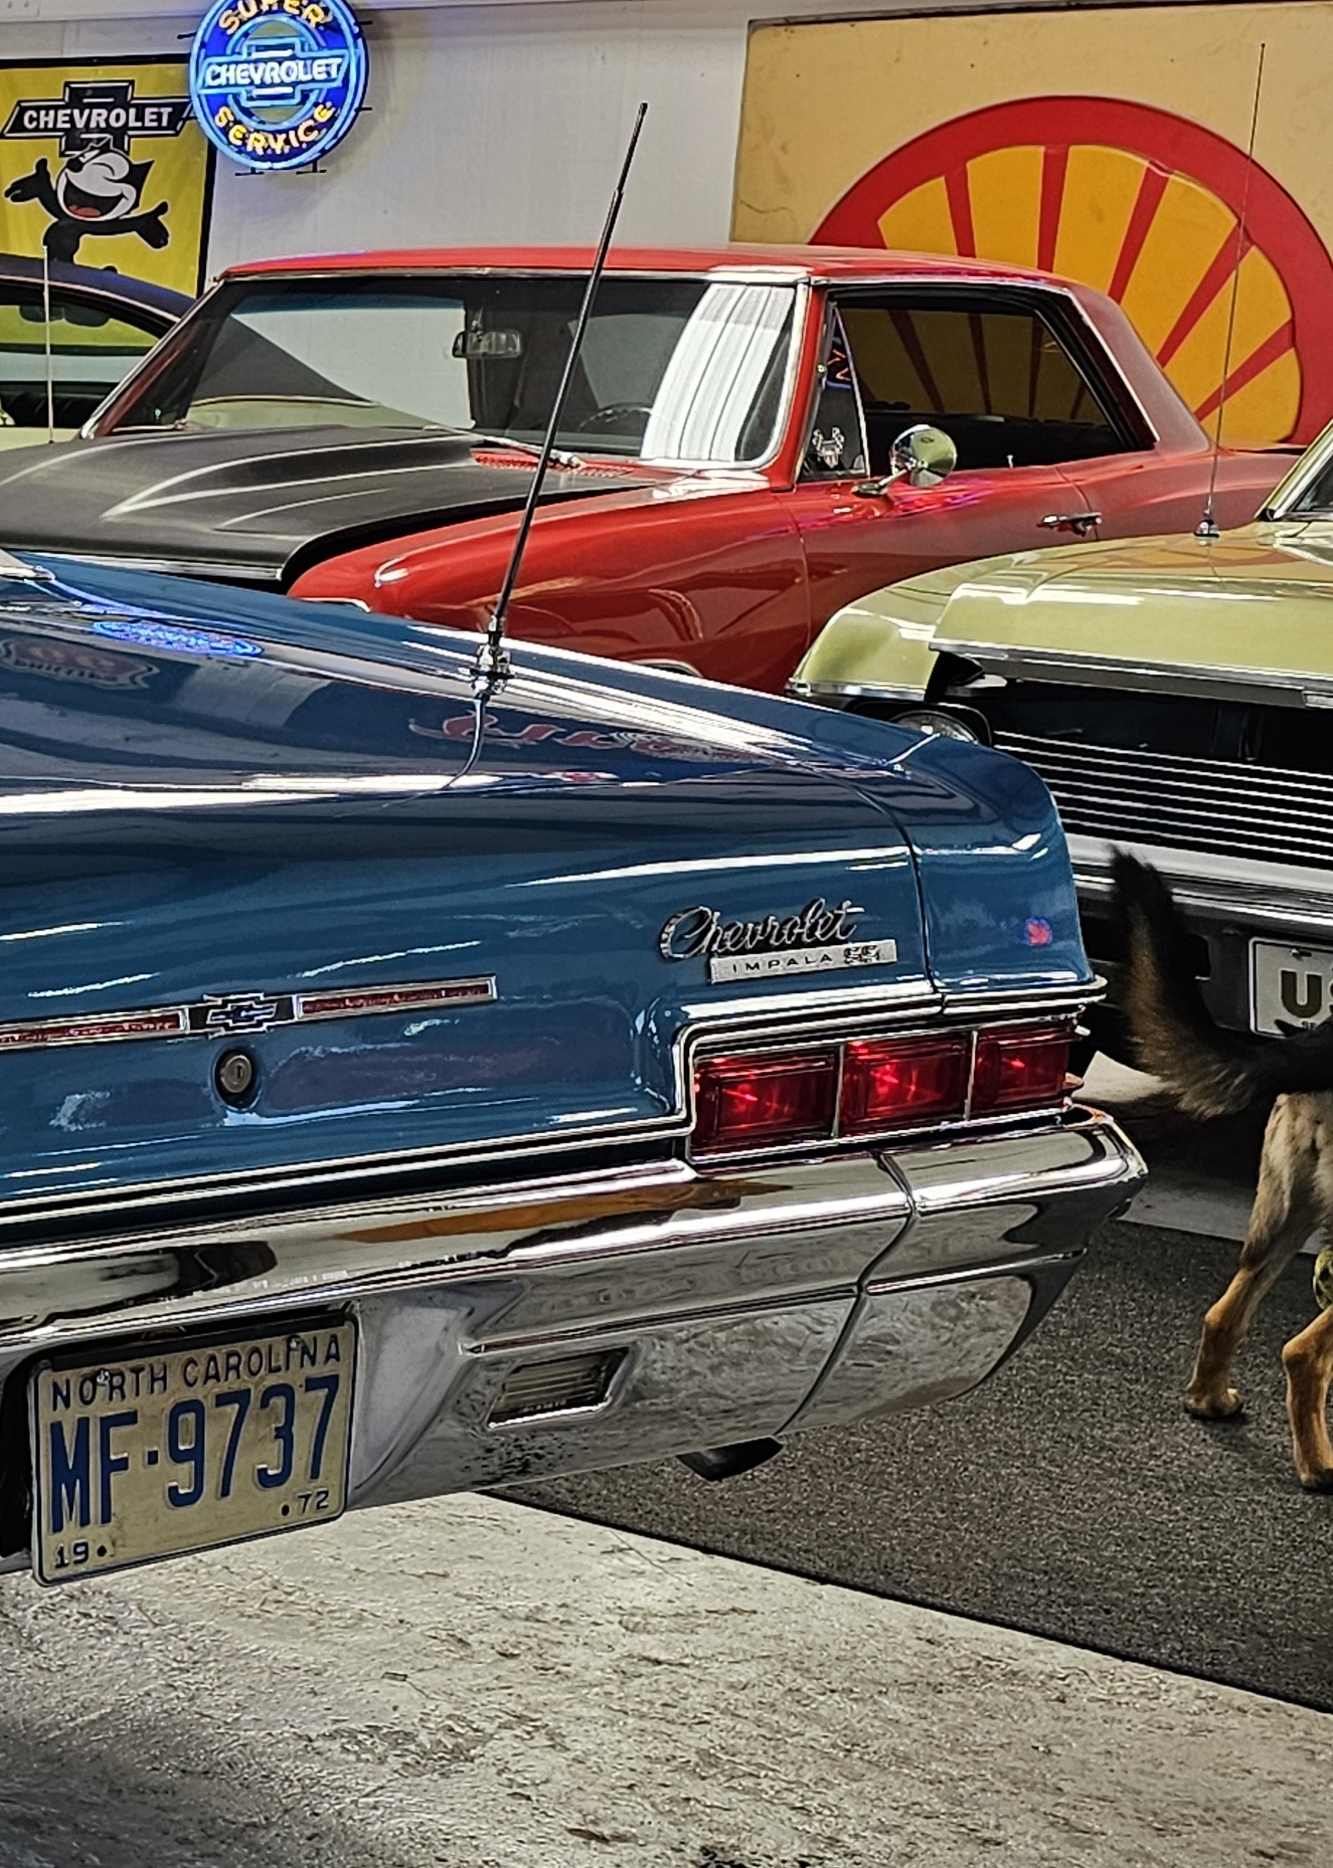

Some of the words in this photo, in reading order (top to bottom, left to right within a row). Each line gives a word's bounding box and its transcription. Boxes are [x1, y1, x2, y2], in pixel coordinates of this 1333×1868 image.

[206, 58, 343, 86] CHEVROLET
[23, 107, 173, 129] CHEVROLET
[214, 102, 335, 155] SERVICE
[659, 897, 865, 962] Chevrolet
[732, 953, 834, 974] IMPALA
[1279, 968, 1333, 1018] U
[52, 1363, 168, 1412] NORTH
[183, 1333, 341, 1388] CAROLINA
[297, 1489, 330, 1514] 72
[54, 1541, 90, 1569] 19
